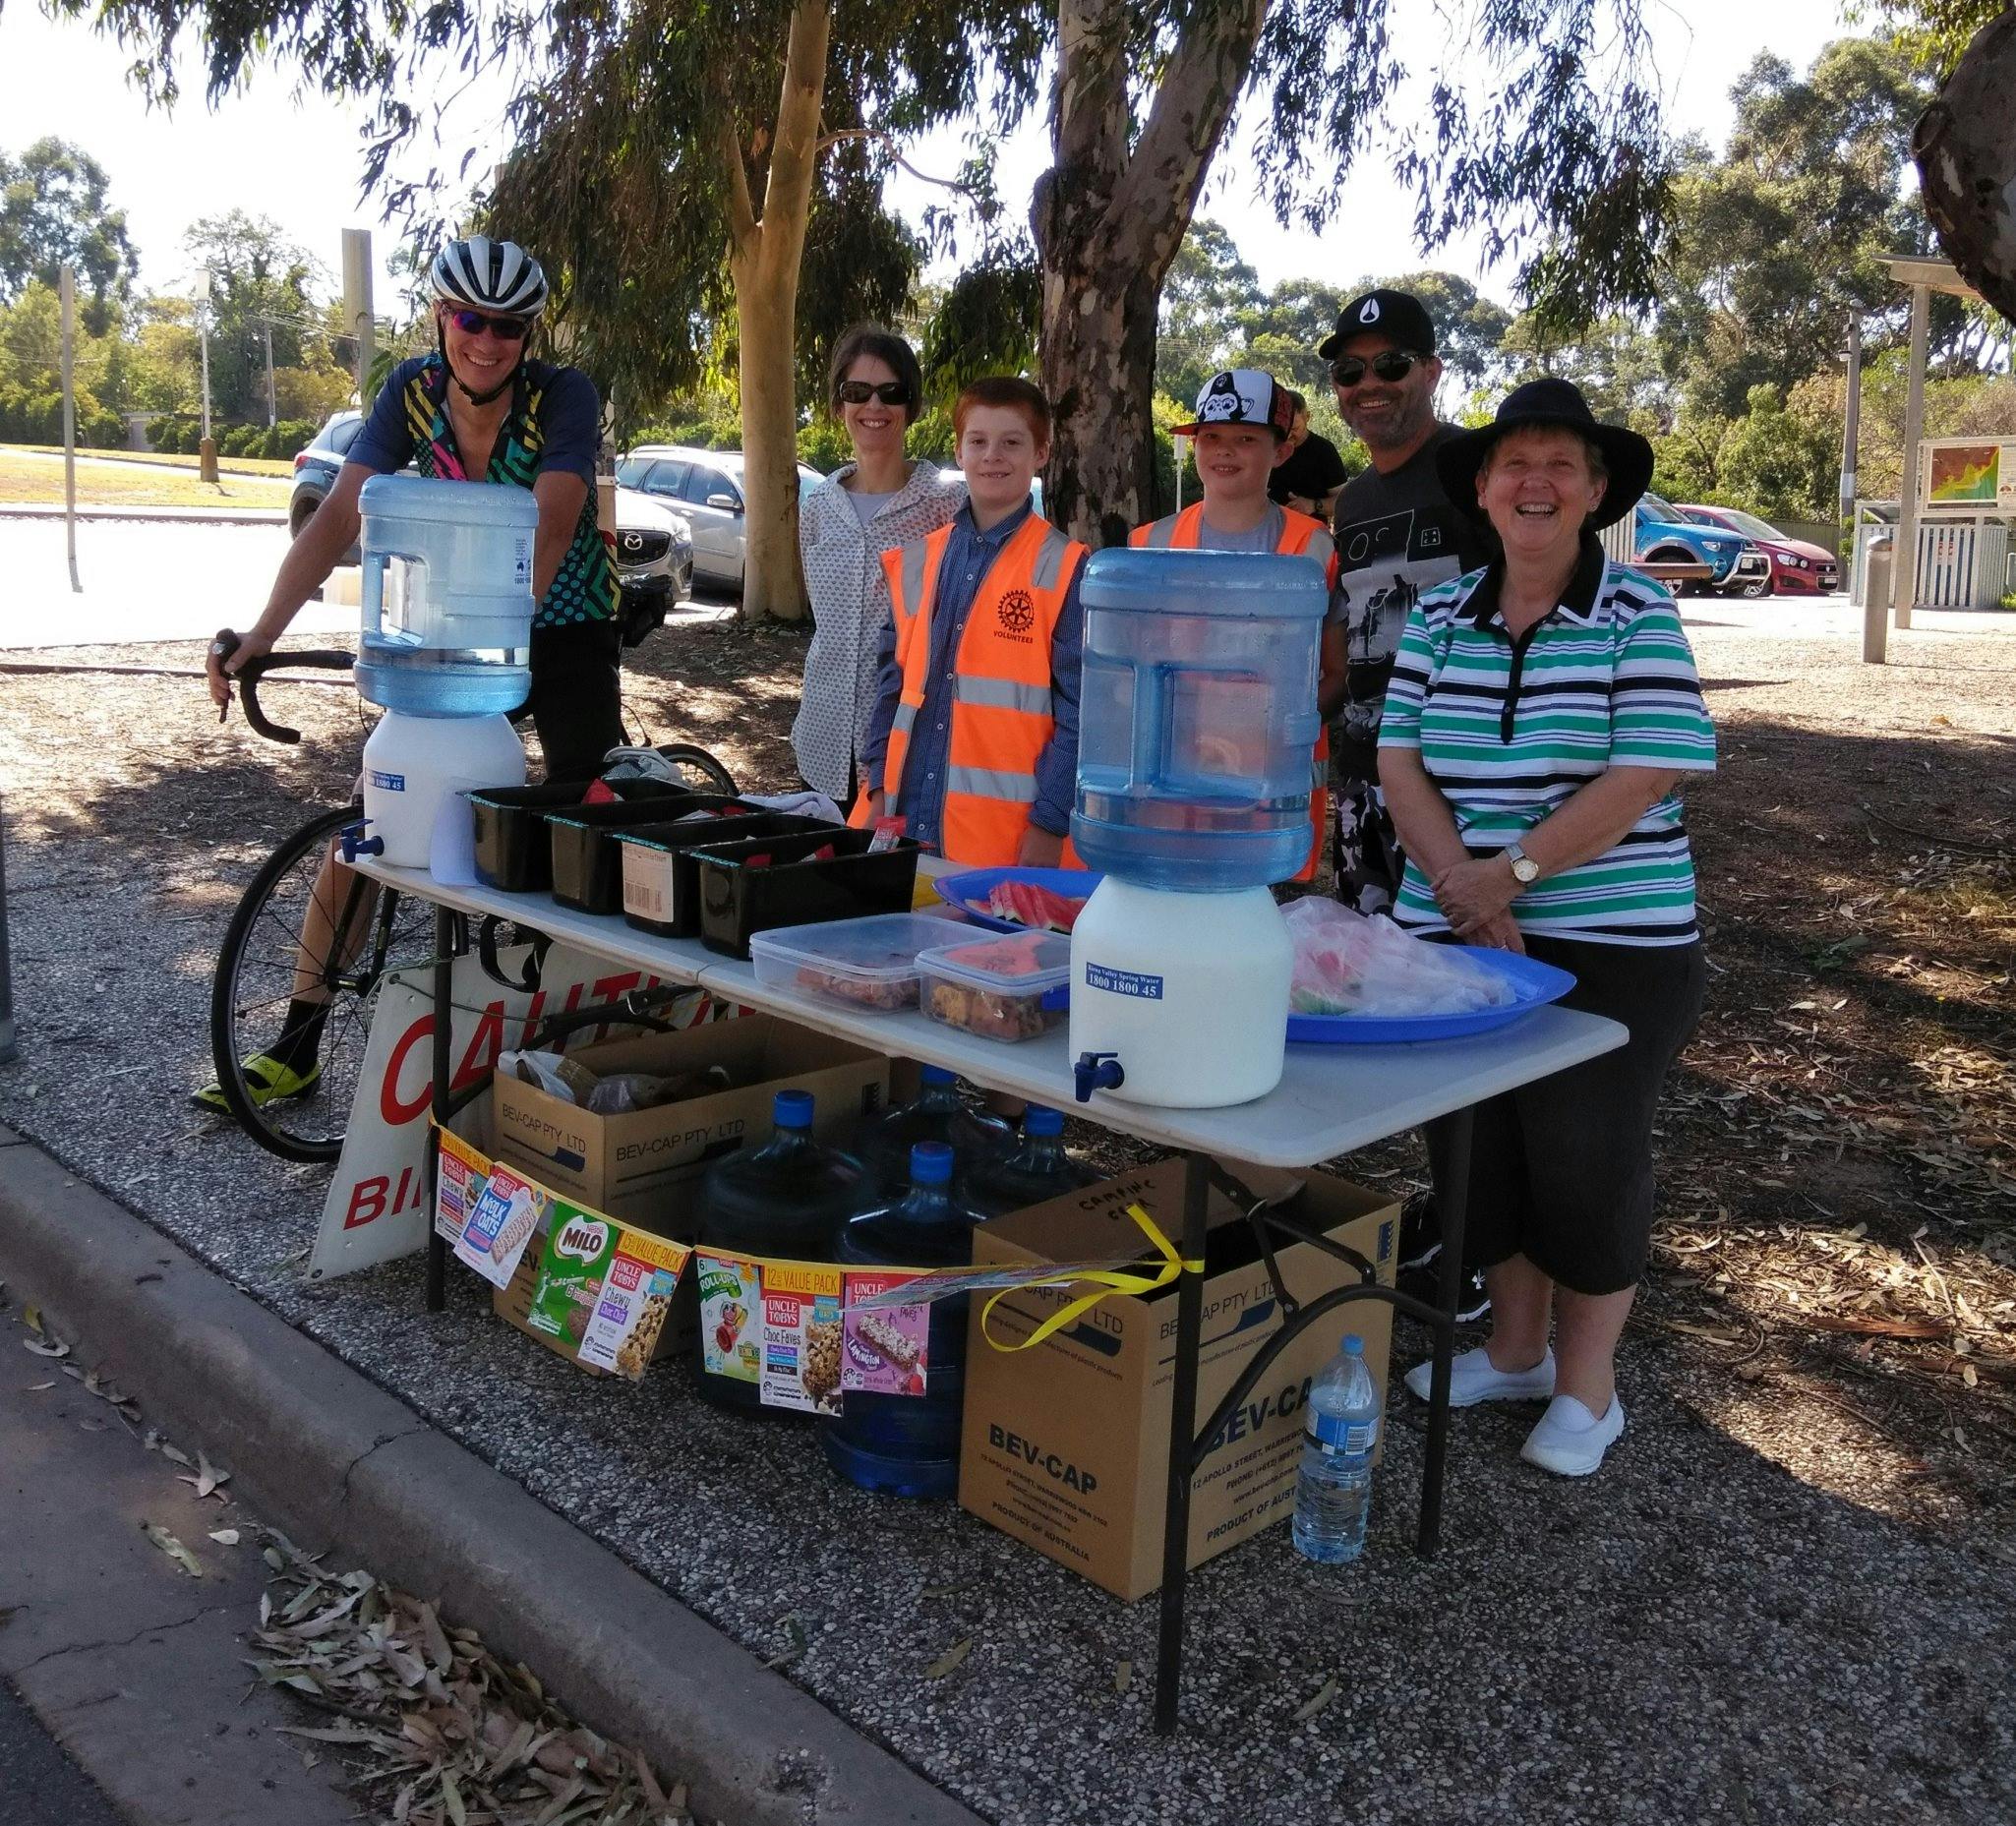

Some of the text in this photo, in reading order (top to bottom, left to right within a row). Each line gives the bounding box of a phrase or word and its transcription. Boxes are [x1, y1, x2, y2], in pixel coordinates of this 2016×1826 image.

[1090, 972, 1156, 997] 1800 1800 45
[1101, 969, 1117, 978] Valley
[1119, 972, 1139, 983] Spring
[503, 1103, 586, 1153] BEV-CAP PTY LTD
[616, 1118, 745, 1162] BEV-CAP PTY LTD
[445, 1155, 465, 1172] UNCLE
[497, 1176, 515, 1193] UNCLE
[477, 1213, 500, 1236] OATS
[563, 1227, 602, 1253] MILO
[622, 1231, 682, 1269] 15 VALUE PACK
[616, 1260, 640, 1278] UNCLE
[699, 1260, 705, 1270] 6
[614, 1271, 638, 1289] TOBYS
[700, 1272, 738, 1292] ROLL-UPS
[767, 1267, 837, 1292] 12 VALUE PACK
[855, 1282, 884, 1294] UNCLE
[604, 1286, 630, 1309] Chewy
[769, 1300, 798, 1314] UNCLE
[1222, 1289, 1249, 1315] PTY
[769, 1312, 798, 1325] TOBYS
[1056, 1292, 1078, 1308] PT
[1094, 1307, 1123, 1334] LTD
[763, 1327, 801, 1345] Choc Faves
[848, 1338, 880, 1365] LAMINGTON
[989, 1423, 1097, 1496] BEV-CAP
[1203, 1463, 1232, 1487] APOLLO
[1207, 1486, 1297, 1542] PRODUCT OF AUST
[991, 1501, 1091, 1562] PRODUCT OF AUSTRALIA
